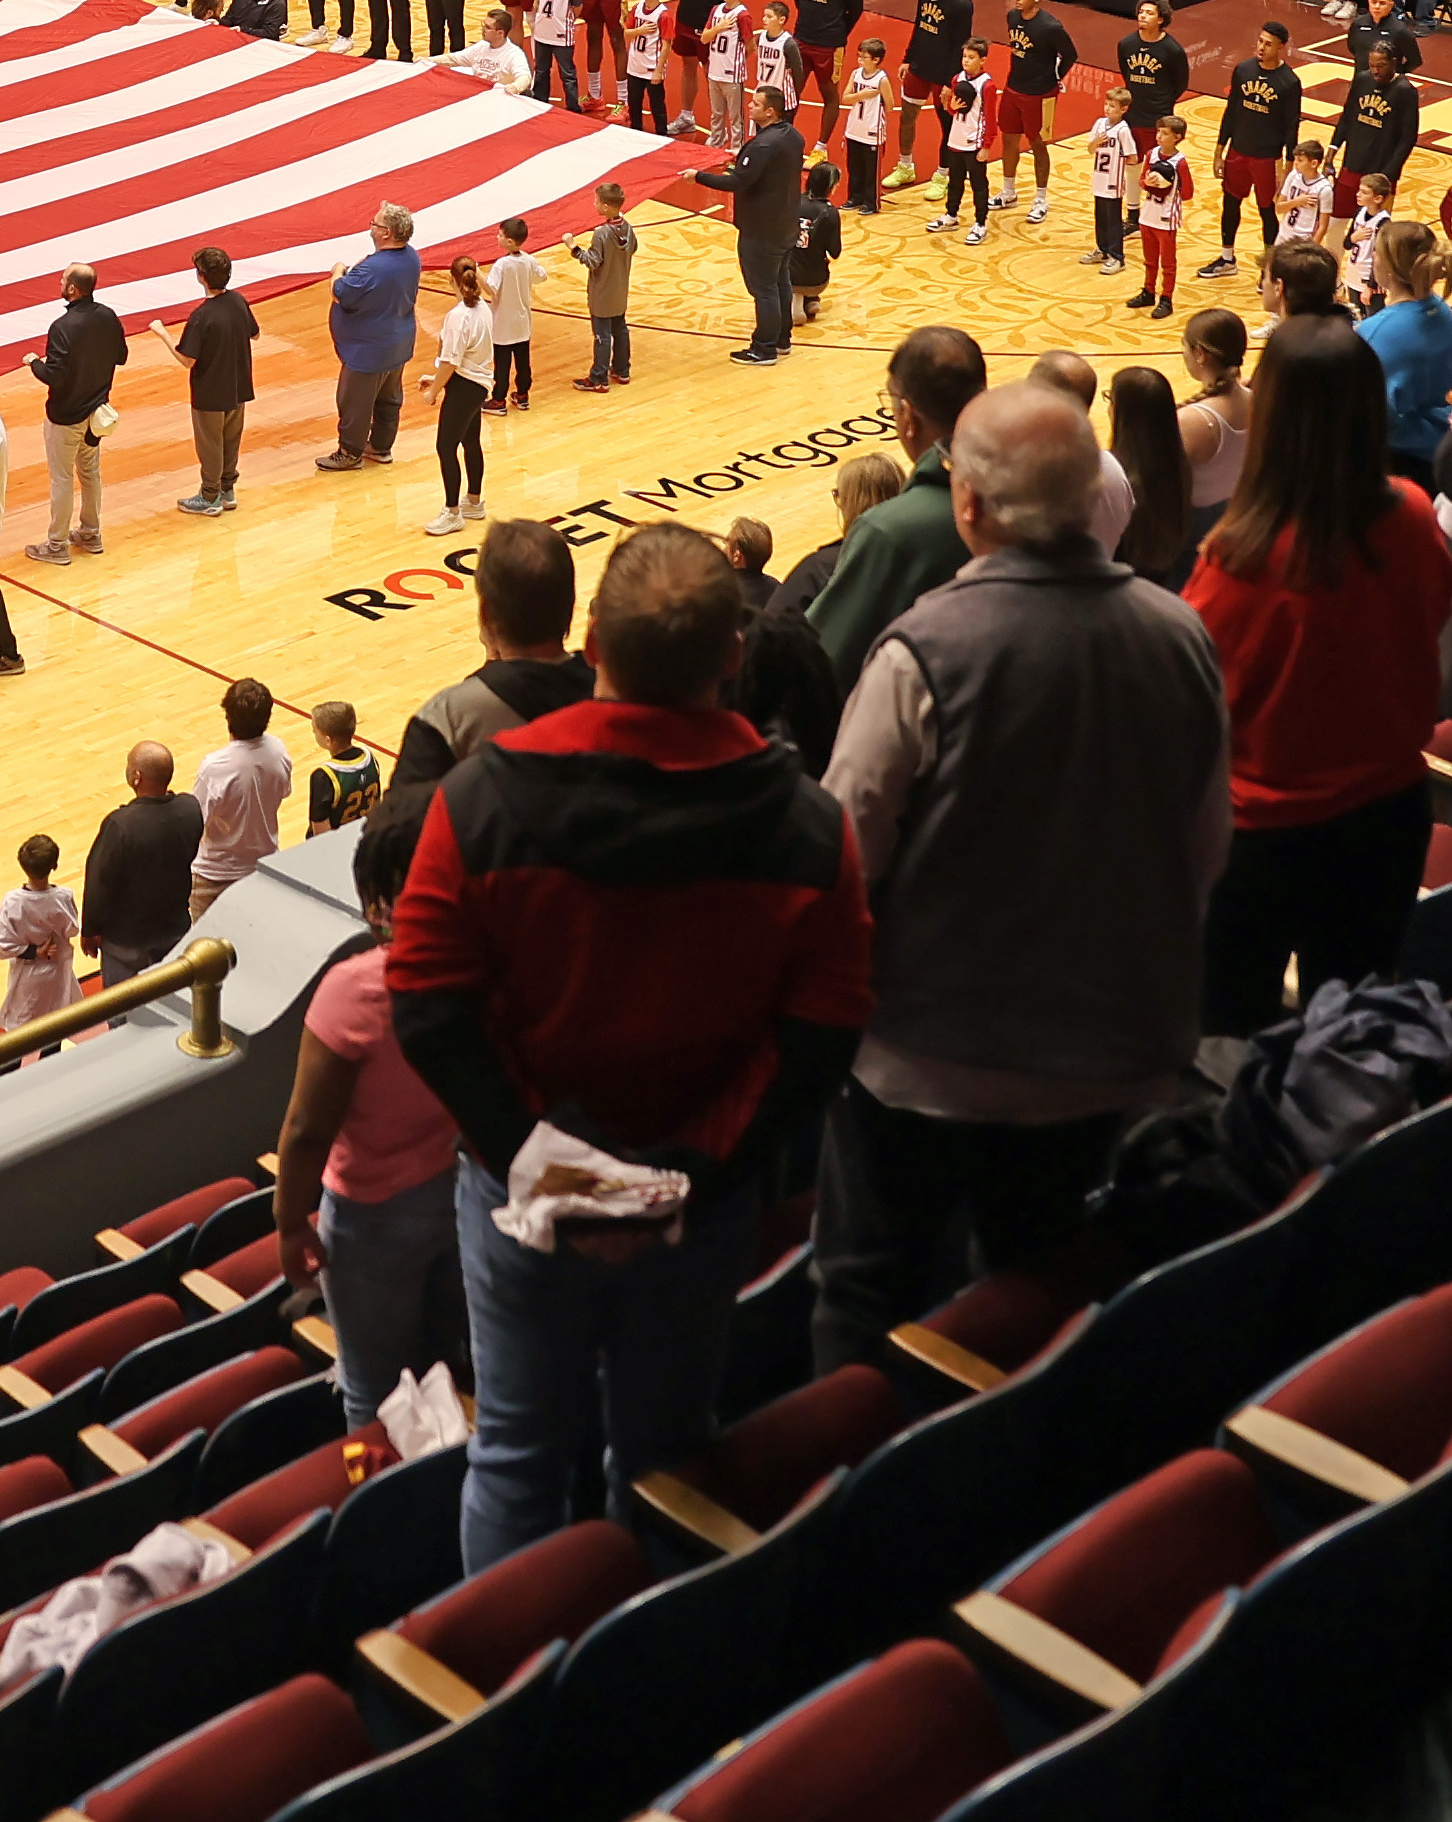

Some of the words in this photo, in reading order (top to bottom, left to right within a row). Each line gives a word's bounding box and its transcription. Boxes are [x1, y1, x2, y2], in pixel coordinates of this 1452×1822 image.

[543, 0, 554, 18] 4
[710, 36, 728, 54] 20
[759, 62, 776, 79] 17
[1126, 54, 1163, 73] CHARGE
[1240, 80, 1279, 102] CHARGE
[1358, 94, 1392, 116] CHARGE
[1094, 151, 1110, 172] 12
[323, 499, 637, 621] ROCET
